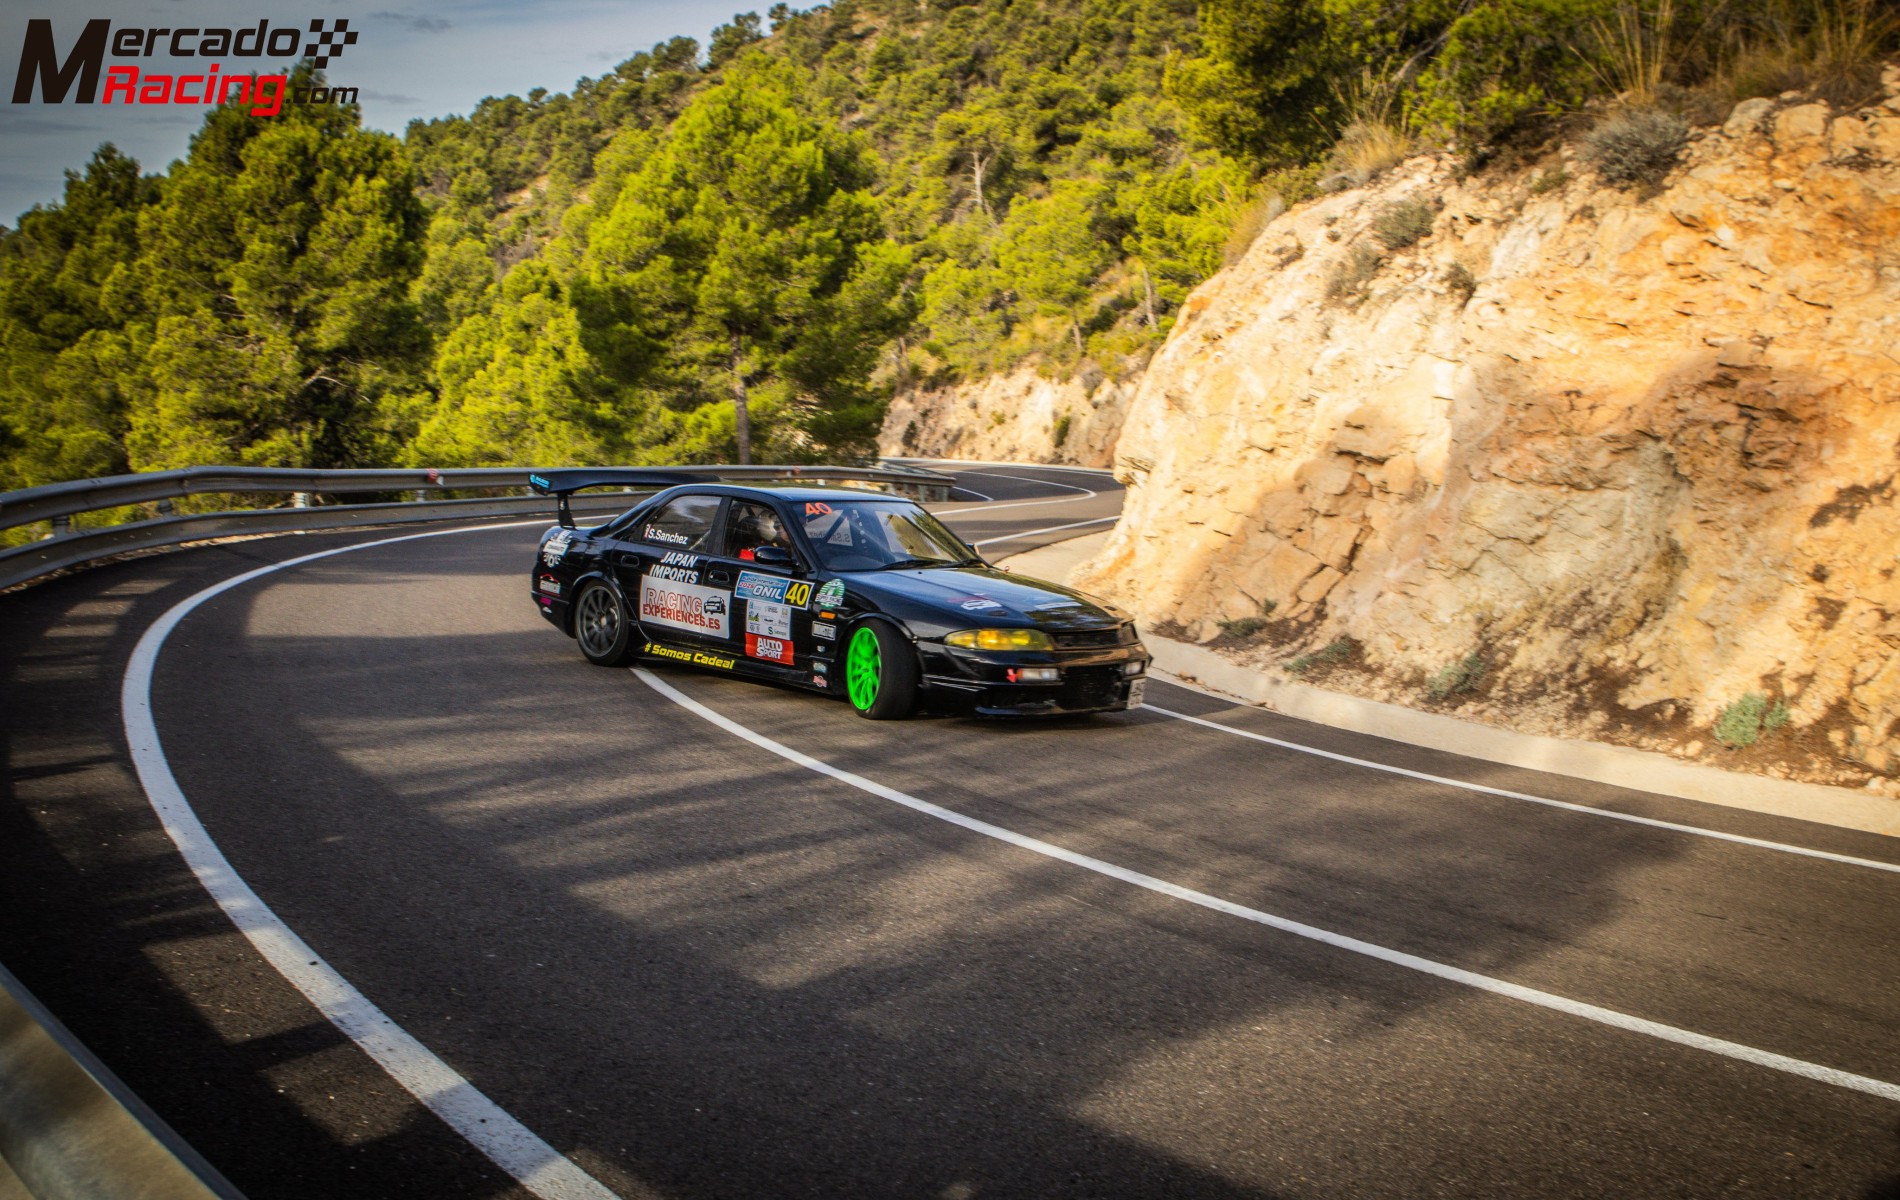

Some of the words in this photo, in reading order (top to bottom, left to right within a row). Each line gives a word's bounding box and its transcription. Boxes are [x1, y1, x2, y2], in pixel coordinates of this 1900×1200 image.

[805, 501, 832, 515] 40
[649, 528, 688, 545] S.Sanchez
[661, 552, 699, 568] JAPAN
[650, 564, 699, 584] IMPORTS
[752, 584, 782, 600] ONIL
[785, 583, 809, 606] 40
[646, 588, 703, 615] RACING
[643, 604, 721, 630] EXPERIENCES.ES
[757, 638, 783, 651] AUTO
[651, 644, 692, 661] Somos
[693, 652, 735, 670] Cadeal
[756, 648, 783, 660] SPORT
